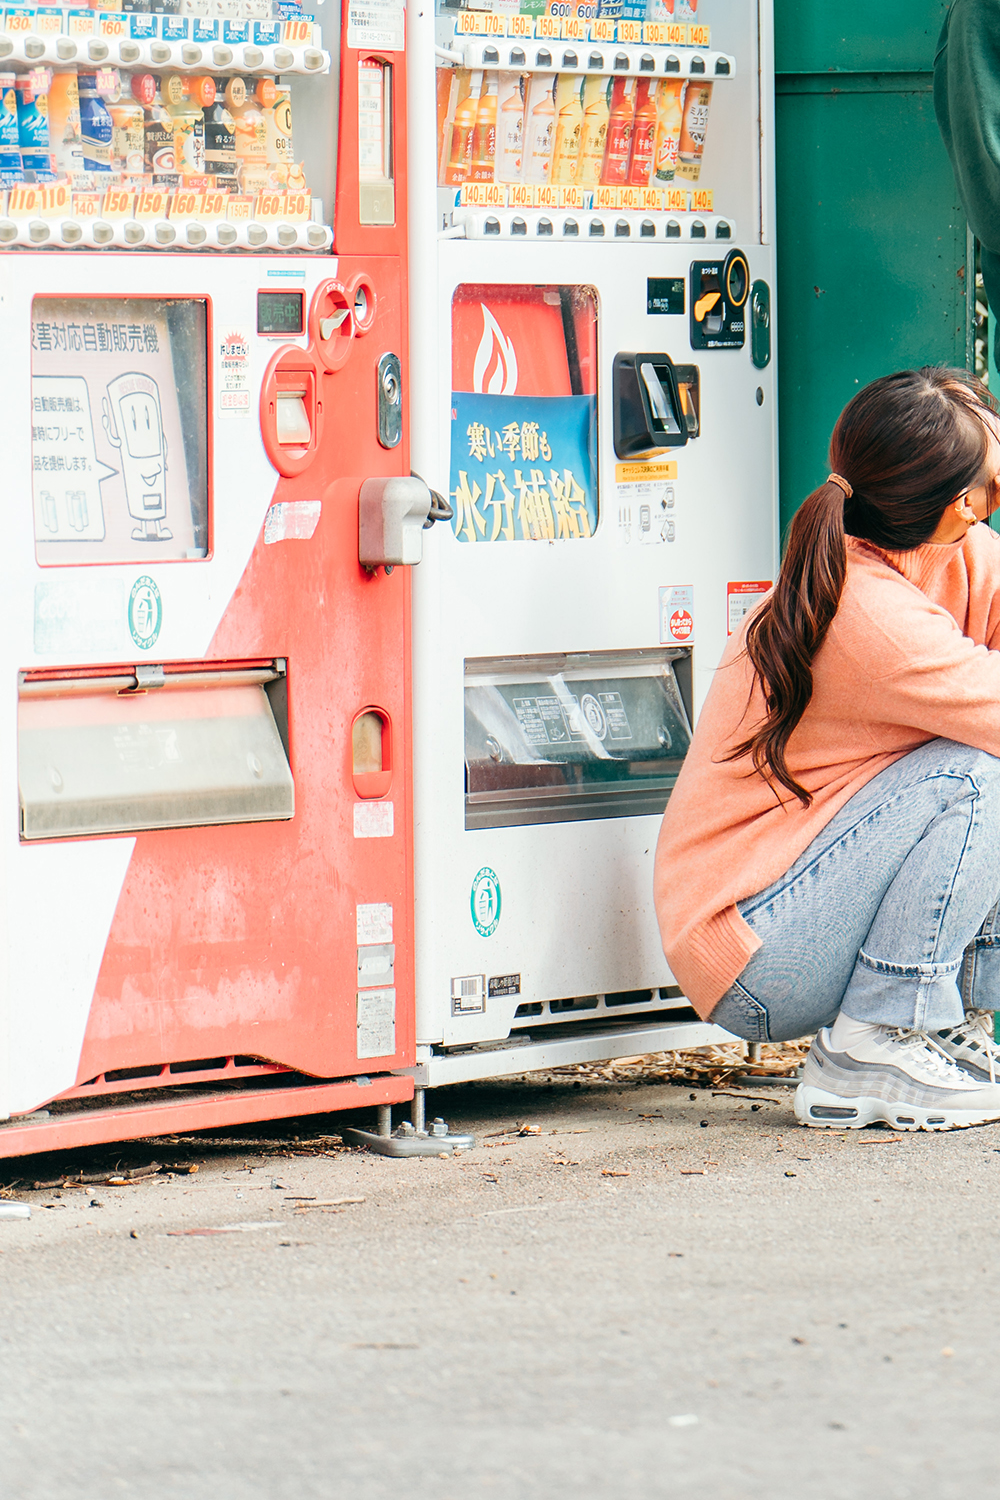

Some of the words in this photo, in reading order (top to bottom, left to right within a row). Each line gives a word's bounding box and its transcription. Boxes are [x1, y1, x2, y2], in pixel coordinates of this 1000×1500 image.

[461, 14, 479, 33] 160円
[484, 15, 503, 34] 170円
[512, 17, 530, 35] 150円
[540, 18, 558, 36] 150円
[565, 20, 583, 38] 140円
[594, 21, 612, 39] 140円
[621, 23, 638, 41] 130円
[646, 25, 664, 42] 130円
[667, 26, 685, 43] 140円
[690, 27, 708, 44] 140円
[465, 185, 483, 203] 140円
[485, 185, 503, 203] 140円
[512, 186, 531, 204] 140円
[537, 187, 556, 205] 140円
[563, 188, 580, 206] 140円
[596, 188, 614, 206] 140円
[620, 189, 637, 207] 140円
[643, 190, 660, 208] 140円
[668, 190, 685, 208] 140円
[693, 191, 711, 209] 140円
[260, 303, 299, 323] 販売中
[466, 421, 553, 462] 寒い季節も
[451, 468, 591, 543] 水分補給
